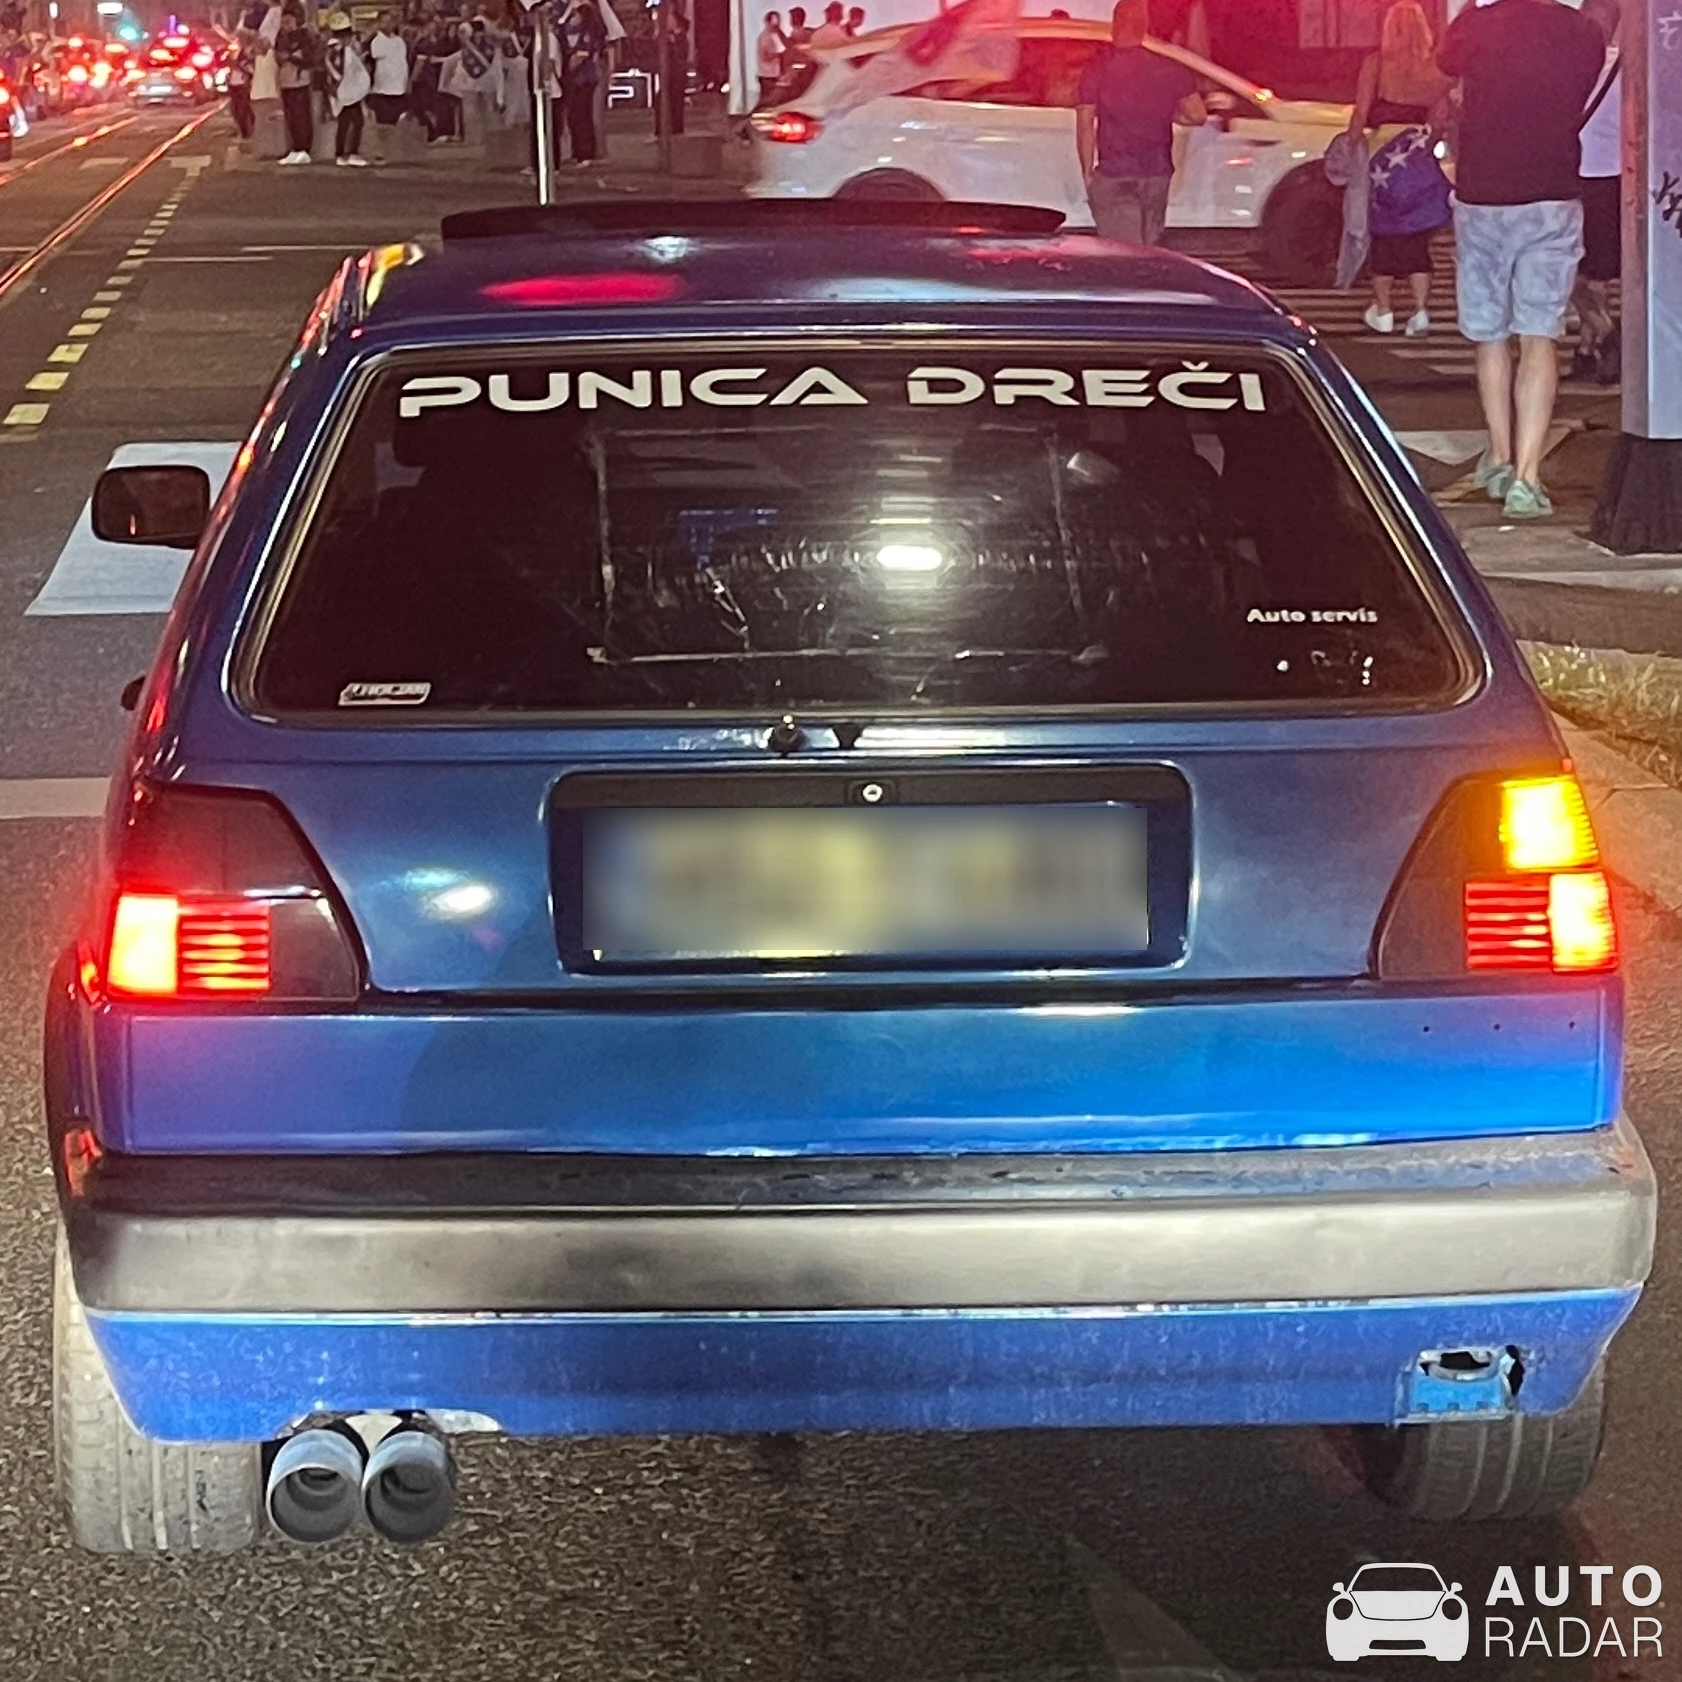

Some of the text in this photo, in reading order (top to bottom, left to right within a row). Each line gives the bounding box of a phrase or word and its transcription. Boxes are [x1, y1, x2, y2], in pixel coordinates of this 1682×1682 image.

[400, 360, 1266, 417] PUNICA DREČI
[1247, 607, 1378, 623] Auto servis
